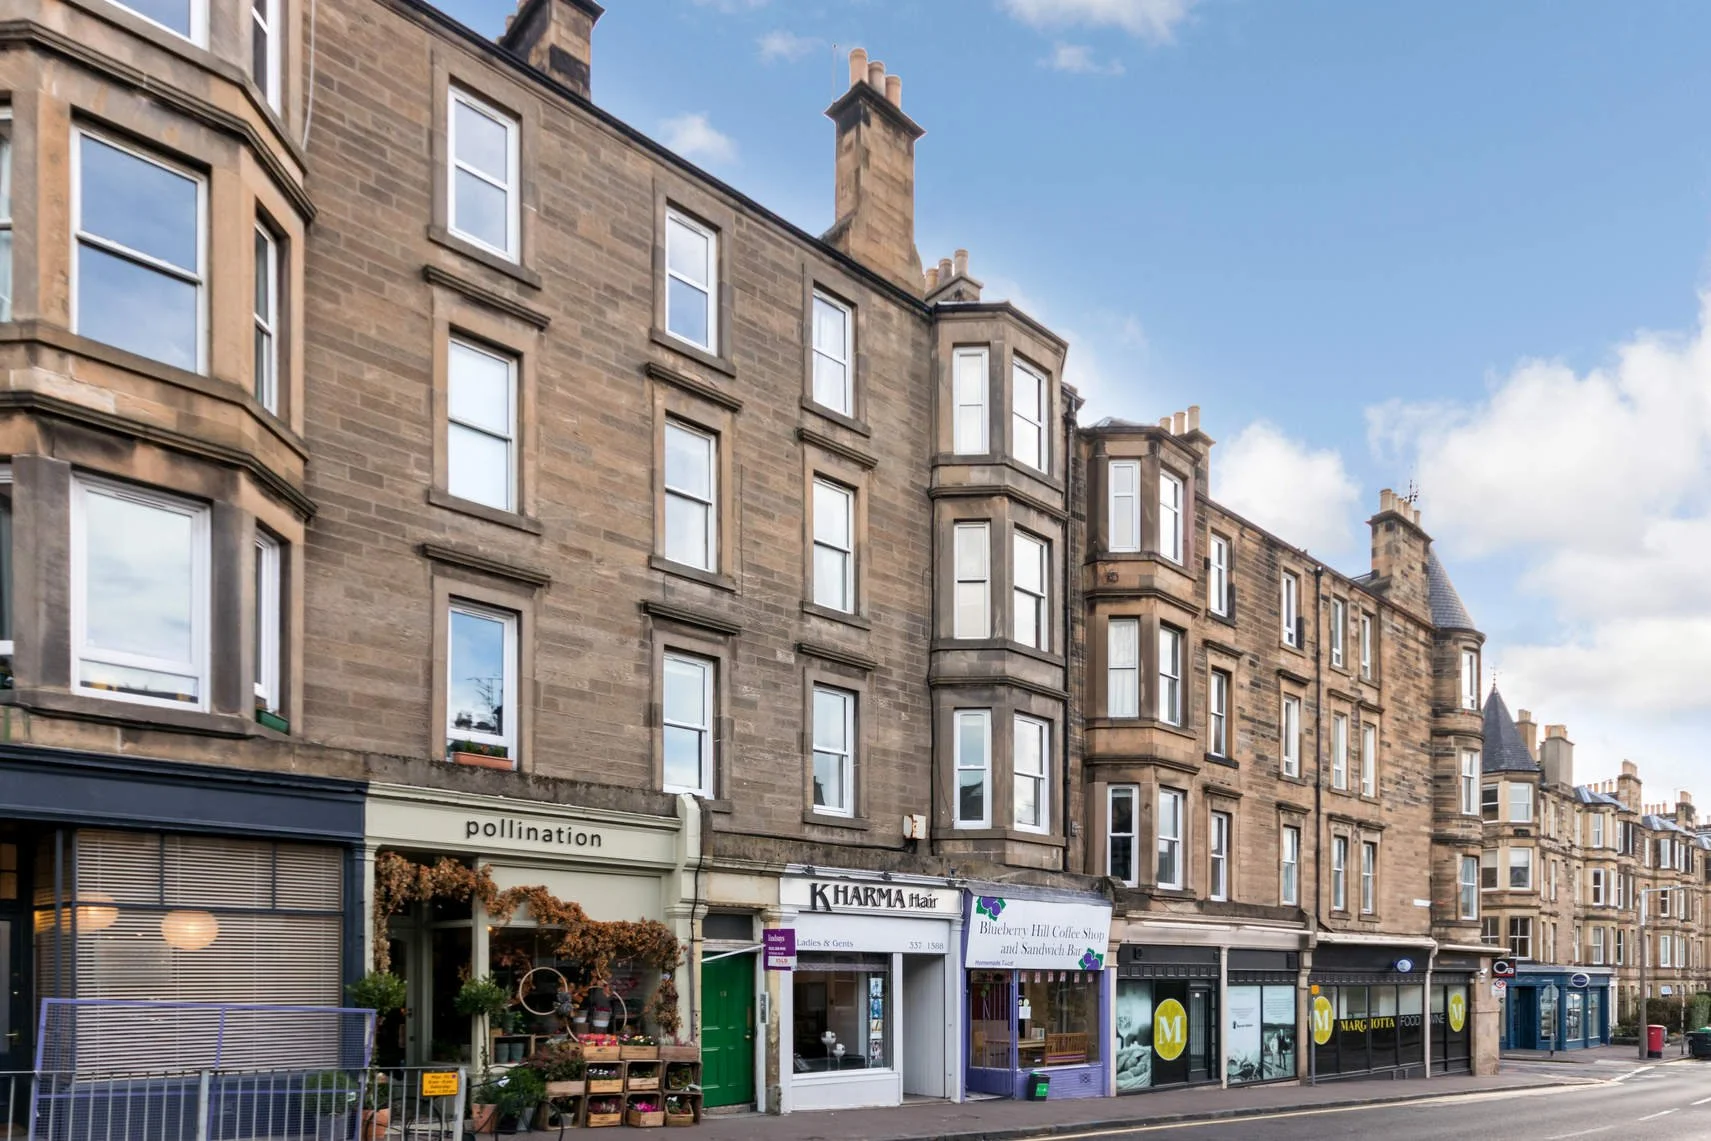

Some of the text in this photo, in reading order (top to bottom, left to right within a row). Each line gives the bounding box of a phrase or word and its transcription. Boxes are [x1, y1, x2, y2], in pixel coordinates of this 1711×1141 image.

[465, 818, 602, 847] pollination
[809, 882, 939, 912] KHARMA Hair
[796, 937, 855, 949] Ladies & Gents
[980, 920, 1105, 943] Blueberry Hill Coffee Shop
[1000, 941, 1083, 957] and Sandwich Bar
[1158, 1015, 1186, 1045] M
[1313, 1009, 1331, 1032] M
[1340, 1017, 1396, 1033] MARGIOTTA
[1400, 1015, 1421, 1027] FOOD
